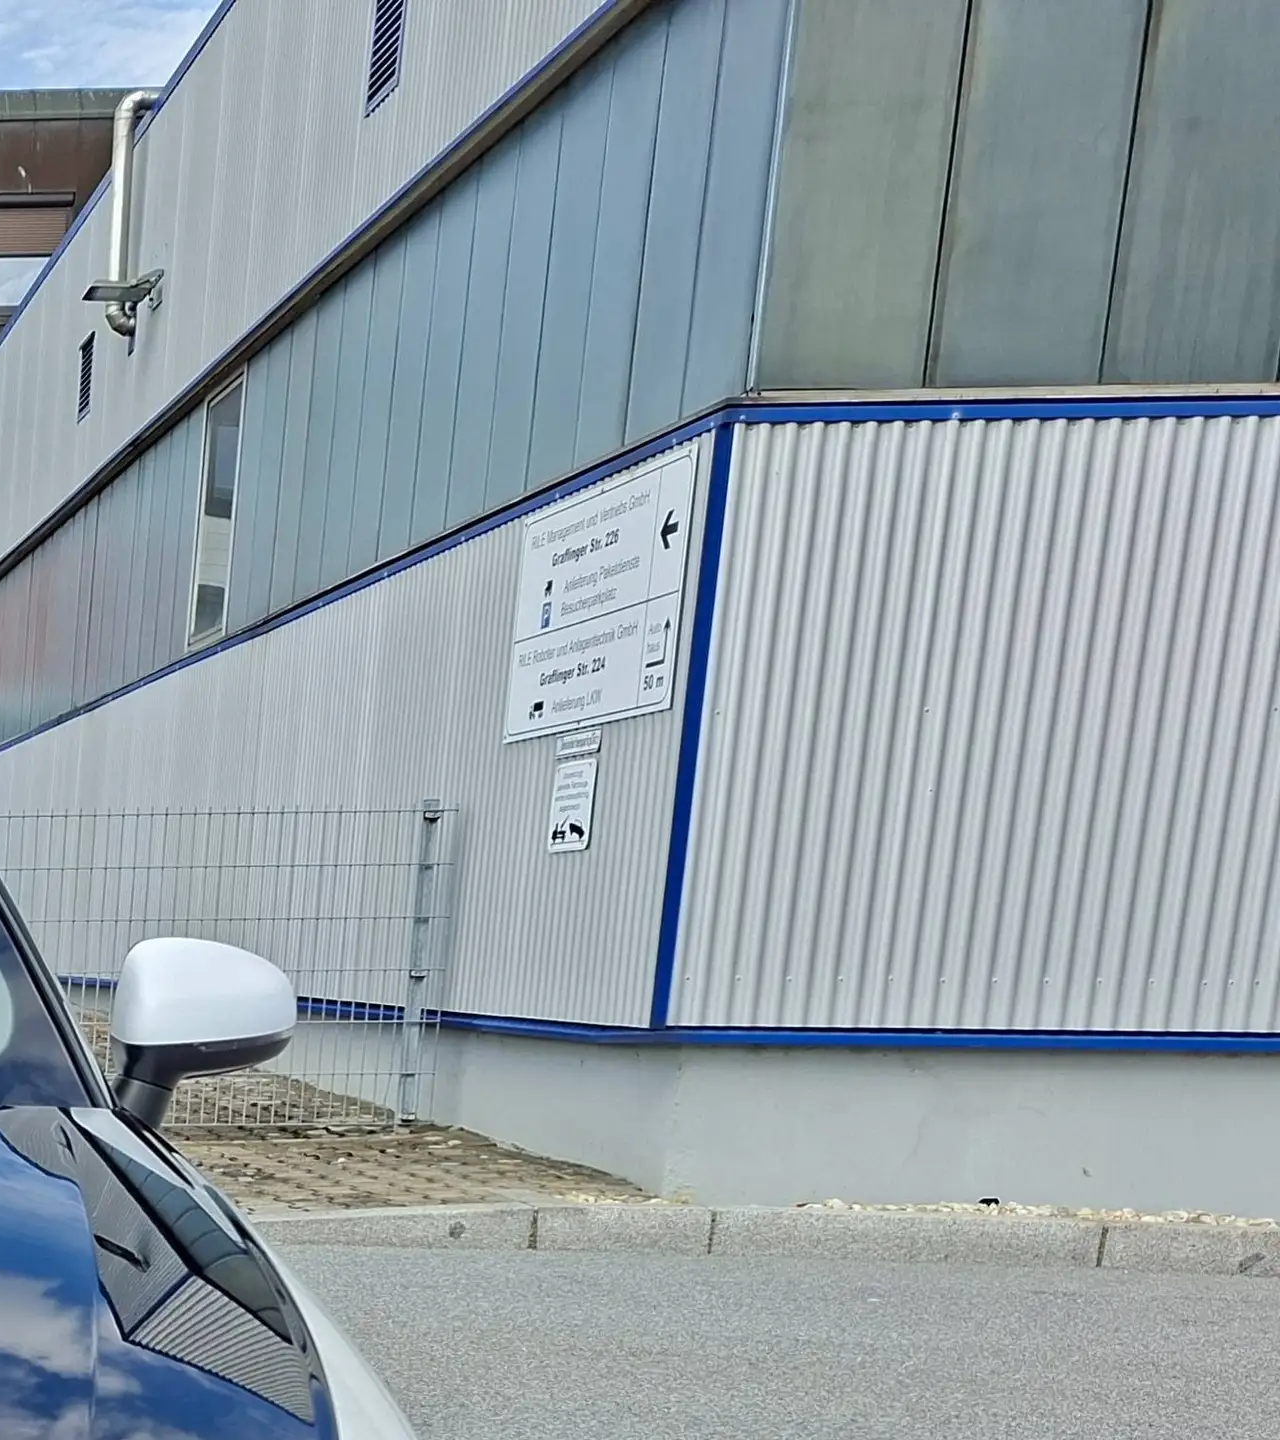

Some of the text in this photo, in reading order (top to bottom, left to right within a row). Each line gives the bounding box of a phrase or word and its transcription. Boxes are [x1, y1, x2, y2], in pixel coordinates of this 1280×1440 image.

[591, 656, 606, 673] 224
[643, 674, 664, 691] 50 m
